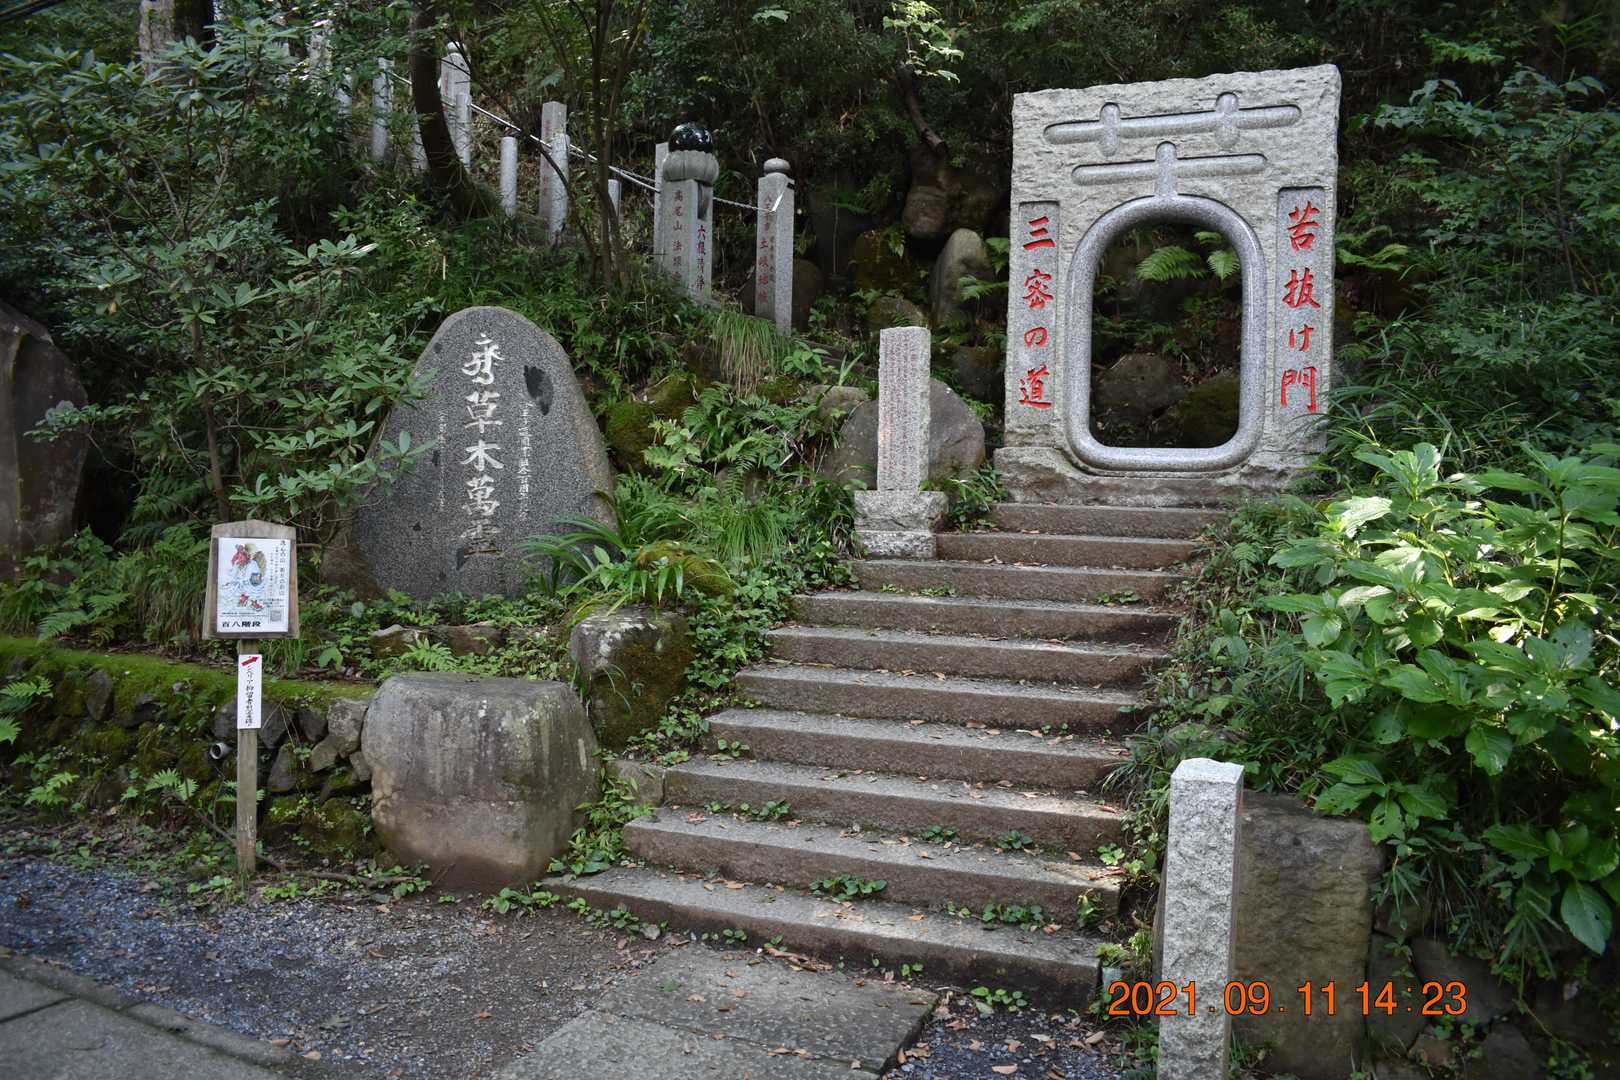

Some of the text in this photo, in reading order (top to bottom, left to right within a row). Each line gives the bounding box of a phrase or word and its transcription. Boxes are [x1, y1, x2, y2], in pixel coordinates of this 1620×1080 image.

[1018, 214, 1056, 409] 三密の道
[1280, 199, 1321, 414] 苦抜け門
[222, 619, 262, 628] 百八階段
